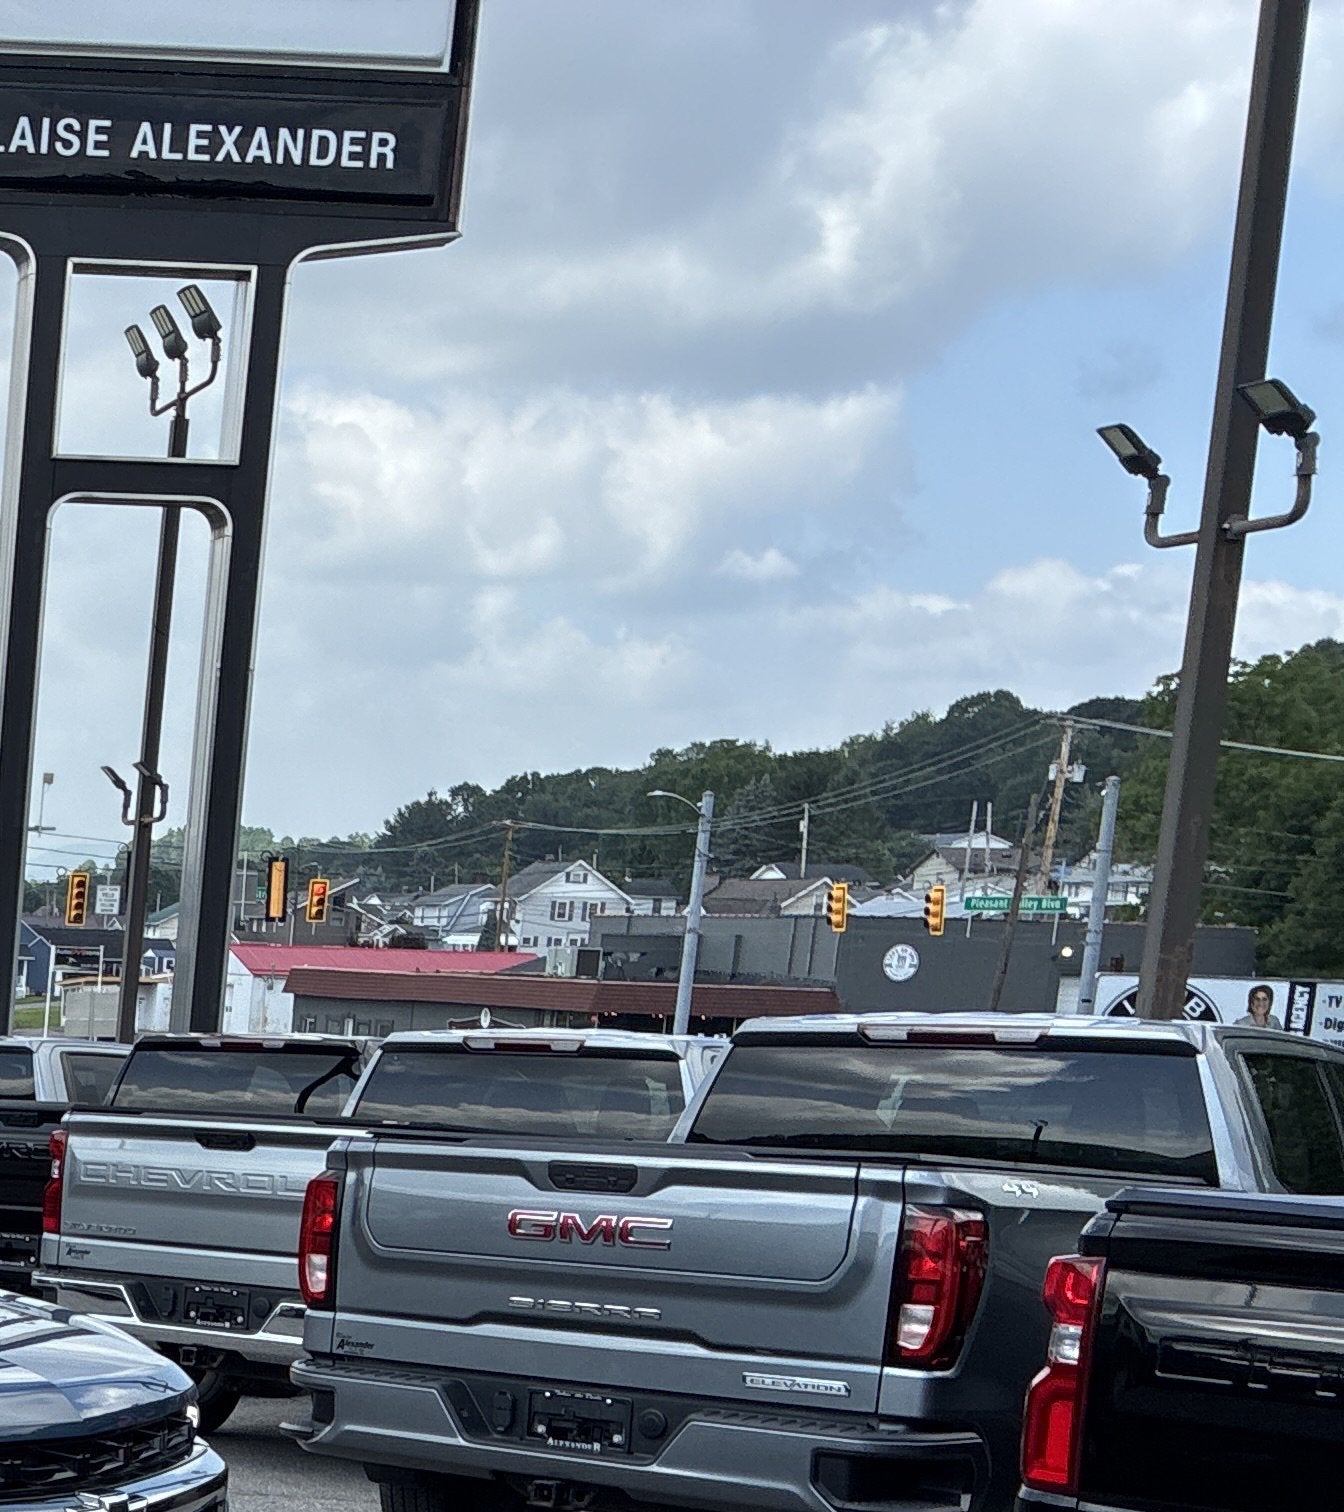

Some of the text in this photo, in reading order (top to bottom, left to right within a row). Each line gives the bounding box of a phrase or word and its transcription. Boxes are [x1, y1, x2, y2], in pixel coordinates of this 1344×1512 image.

[129, 121, 397, 170] ALEXANDER
[970, 899, 1009, 909] Pleasant
[1041, 899, 1061, 909] Blvd
[1327, 995, 1343, 1009] TV
[80, 1162, 305, 1198] CHEVROL
[507, 1208, 674, 1251] GMC
[508, 1296, 663, 1320] SIERRA
[749, 1377, 842, 1393] ELEVATION
[547, 1437, 601, 1453] ALEXANDER
